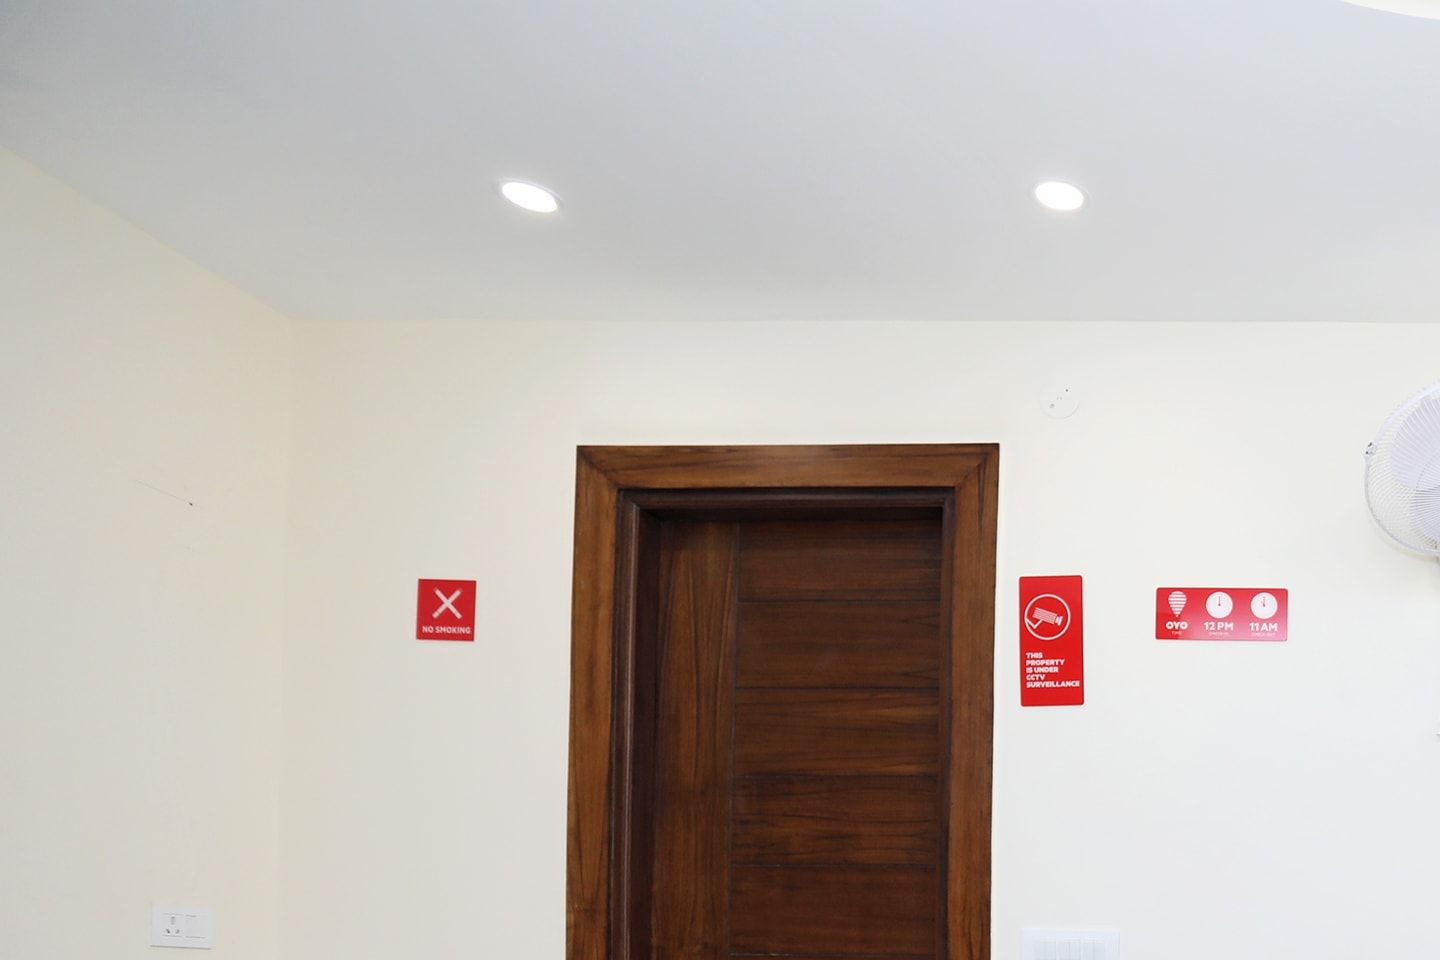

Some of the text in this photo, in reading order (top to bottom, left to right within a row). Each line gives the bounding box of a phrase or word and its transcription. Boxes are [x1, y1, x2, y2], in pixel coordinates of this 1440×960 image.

[422, 625, 471, 634] NO SMOKING
[1165, 621, 1188, 630] OYO
[1203, 621, 1234, 631] 12 PM
[1249, 622, 1278, 632] 11 AM
[1025, 659, 1065, 667] PROPERTY
[1025, 673, 1046, 681] CCTV
[1026, 680, 1080, 688] SURVEILLANCE
